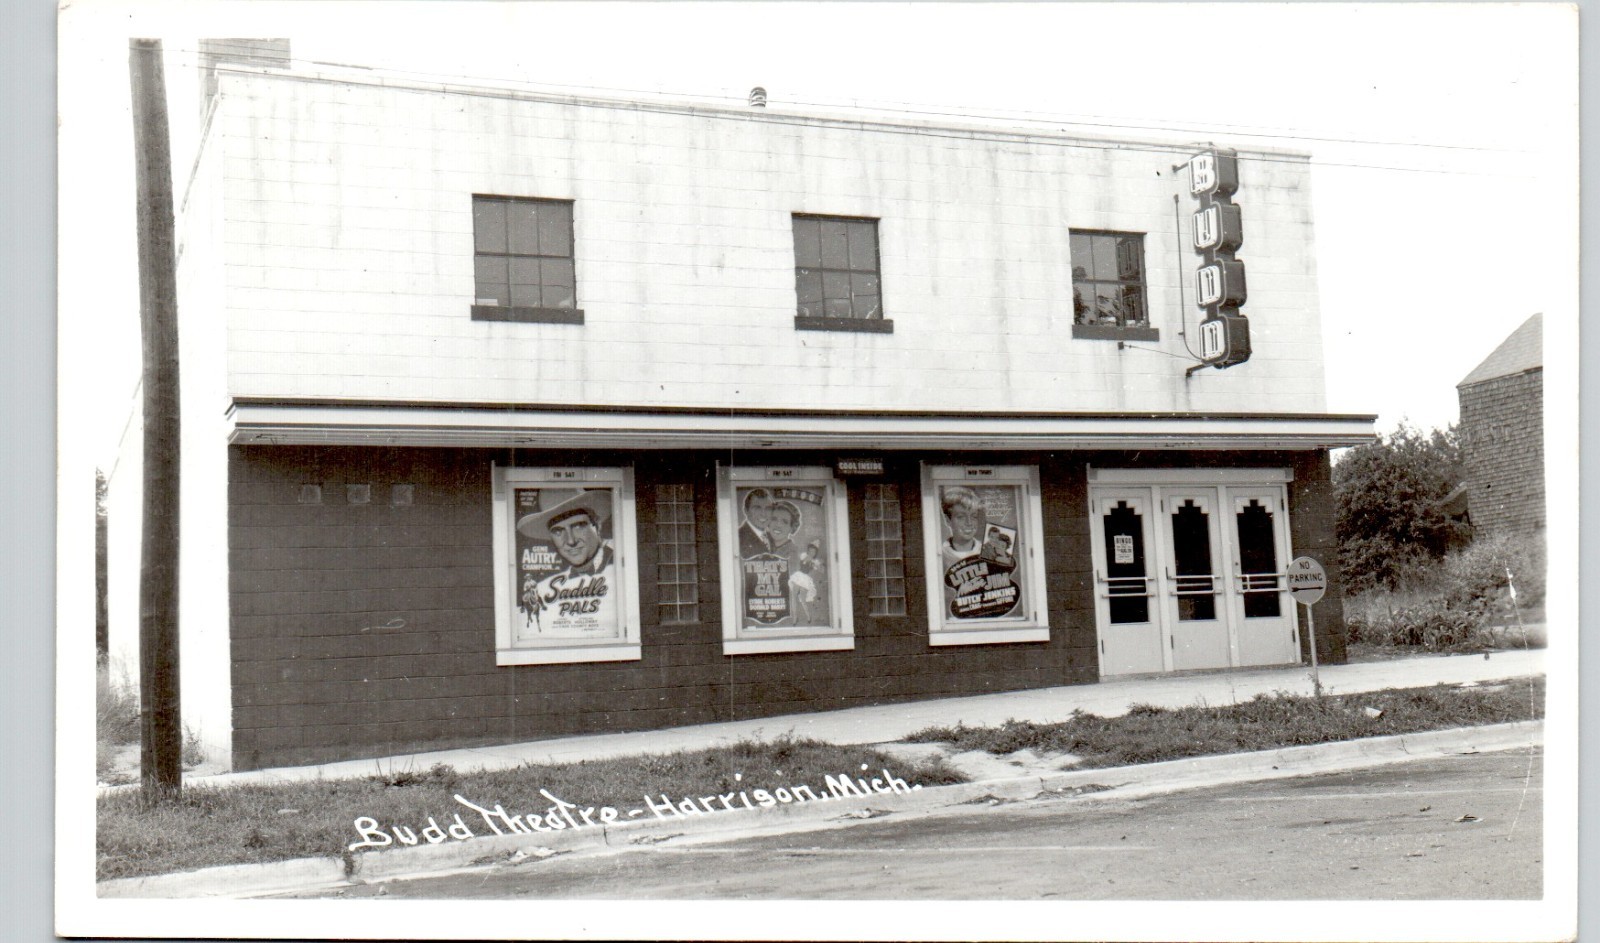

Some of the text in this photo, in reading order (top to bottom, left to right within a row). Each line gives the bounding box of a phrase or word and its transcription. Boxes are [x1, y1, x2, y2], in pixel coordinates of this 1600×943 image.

[1188, 152, 1226, 361] BUDD
[838, 462, 883, 470] COOL INSIDE
[522, 548, 557, 564] AUTRY
[532, 545, 548, 553] GENE
[744, 559, 788, 573] THAT'S
[1299, 561, 1310, 570] NO
[757, 572, 781, 584] MY
[949, 562, 990, 587] LITTLE
[984, 572, 1011, 590] JIM
[1289, 572, 1323, 583] PARKING
[544, 574, 608, 604] Saddle
[755, 584, 782, 597] GAL
[983, 586, 1017, 601] JENKINS
[559, 598, 601, 617] PALS
